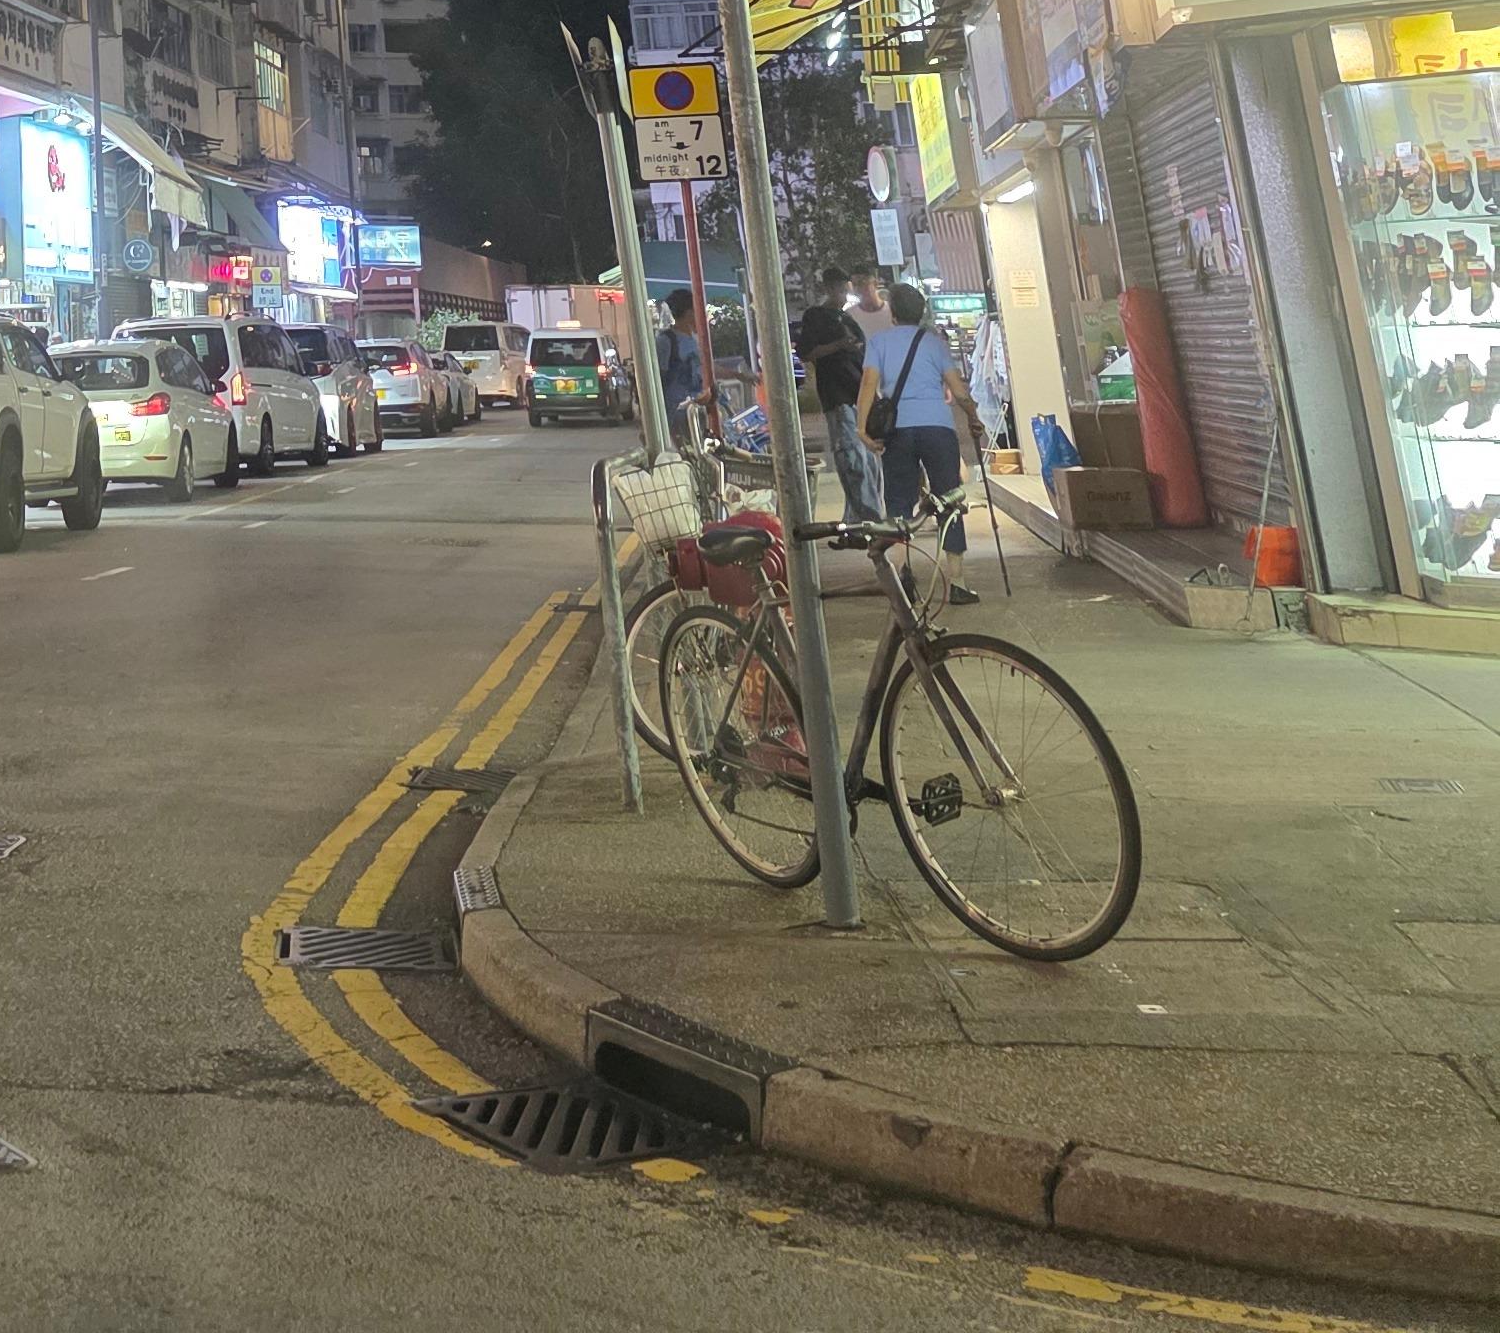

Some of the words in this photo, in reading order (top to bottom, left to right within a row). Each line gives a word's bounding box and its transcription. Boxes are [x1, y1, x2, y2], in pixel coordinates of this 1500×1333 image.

[651, 130, 677, 143] 上午
[689, 120, 703, 141] 7
[643, 153, 690, 165] midnight
[695, 154, 723, 176] 12
[654, 164, 681, 178] 午夜
